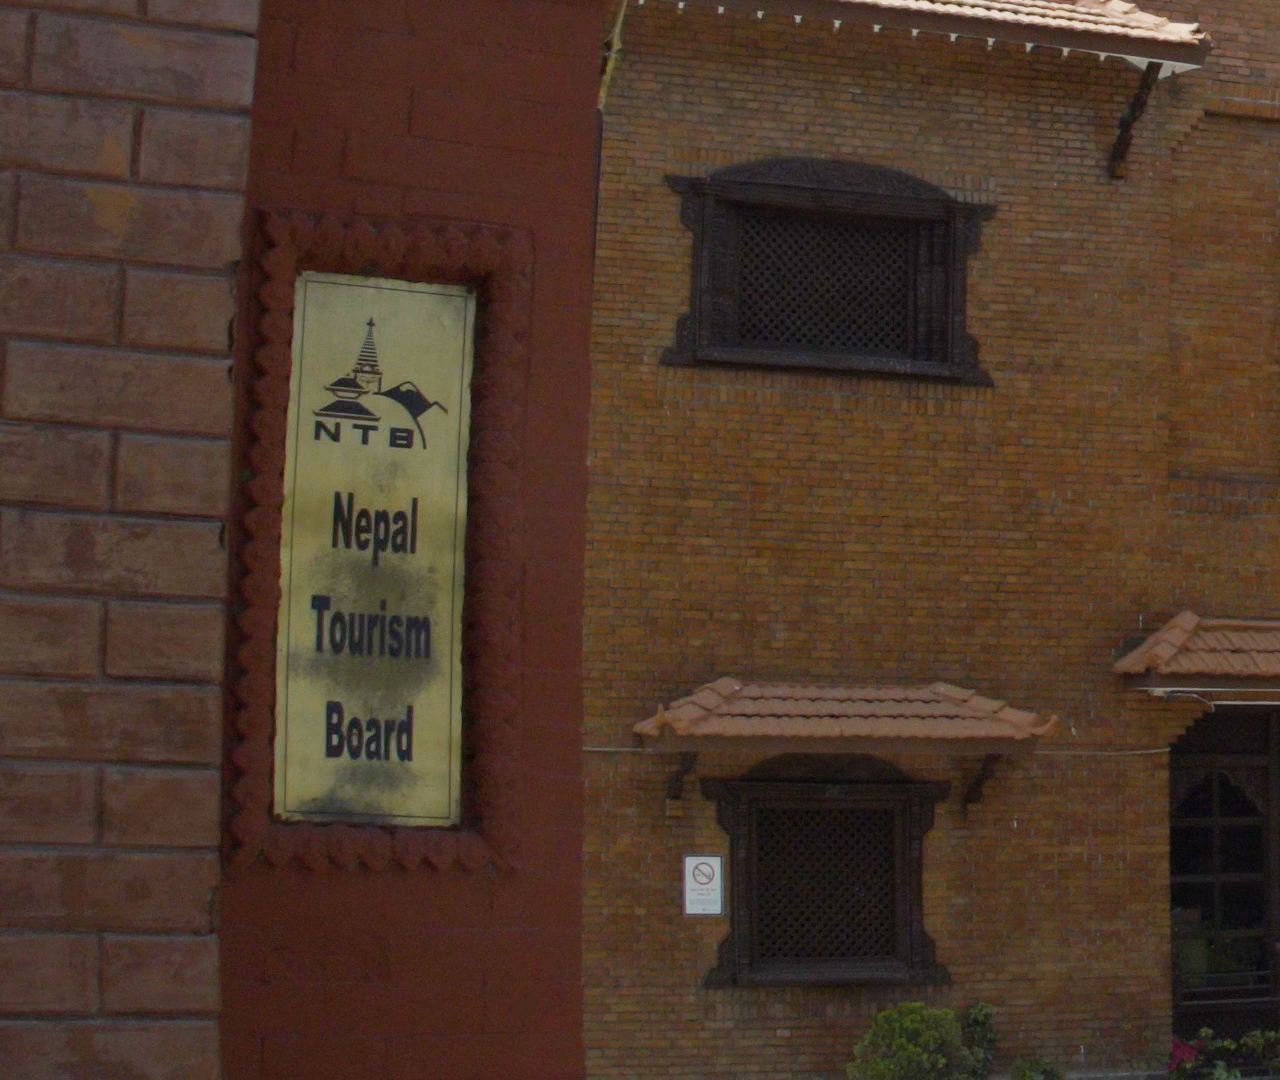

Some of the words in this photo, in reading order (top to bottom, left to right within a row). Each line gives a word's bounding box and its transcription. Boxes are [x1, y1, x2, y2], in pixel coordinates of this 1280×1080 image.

[314, 420, 414, 449] NTB
[331, 491, 418, 566] Nepal
[311, 594, 431, 660] Tourism
[324, 700, 414, 762] Board
